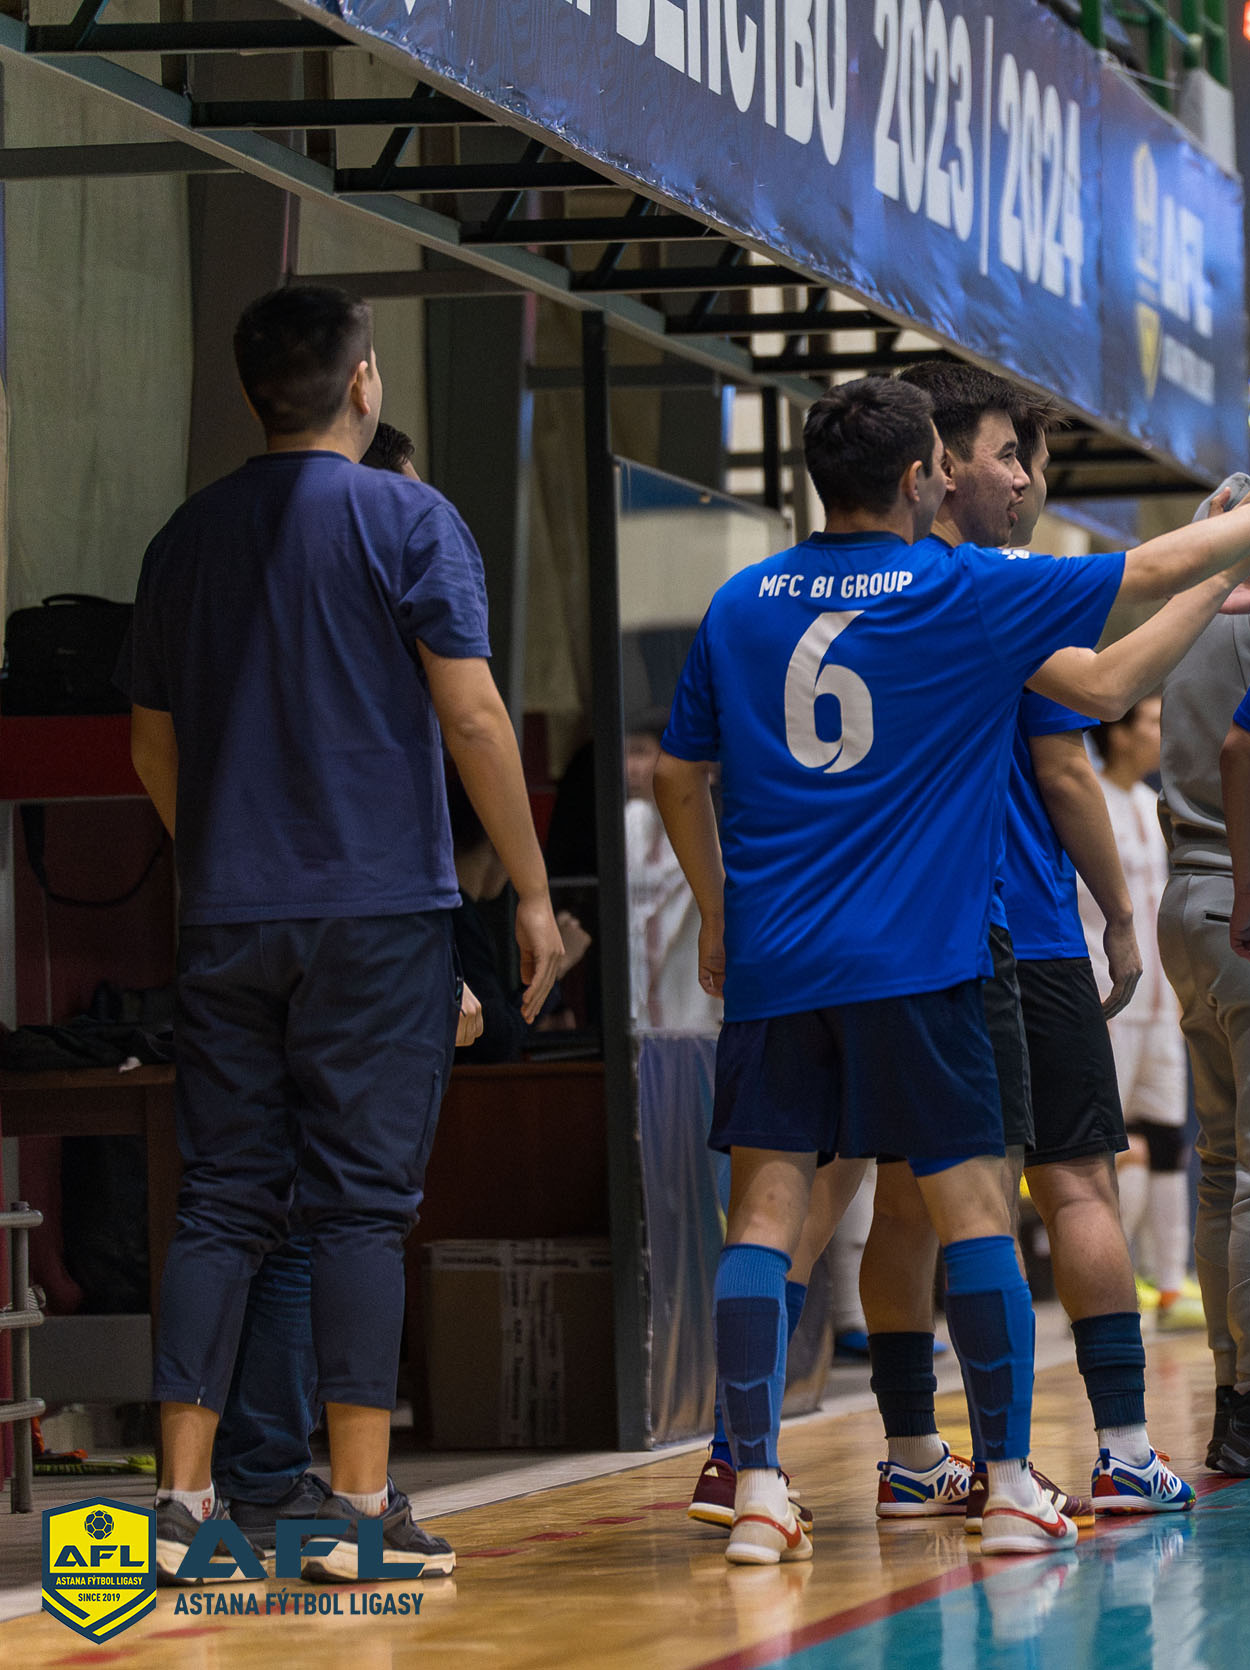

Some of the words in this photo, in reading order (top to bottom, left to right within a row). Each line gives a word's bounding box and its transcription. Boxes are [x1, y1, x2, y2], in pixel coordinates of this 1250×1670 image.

[758, 574, 804, 598] MFC
[810, 576, 834, 598] BI
[840, 571, 913, 599] GROUP
[784, 610, 874, 774] 6
